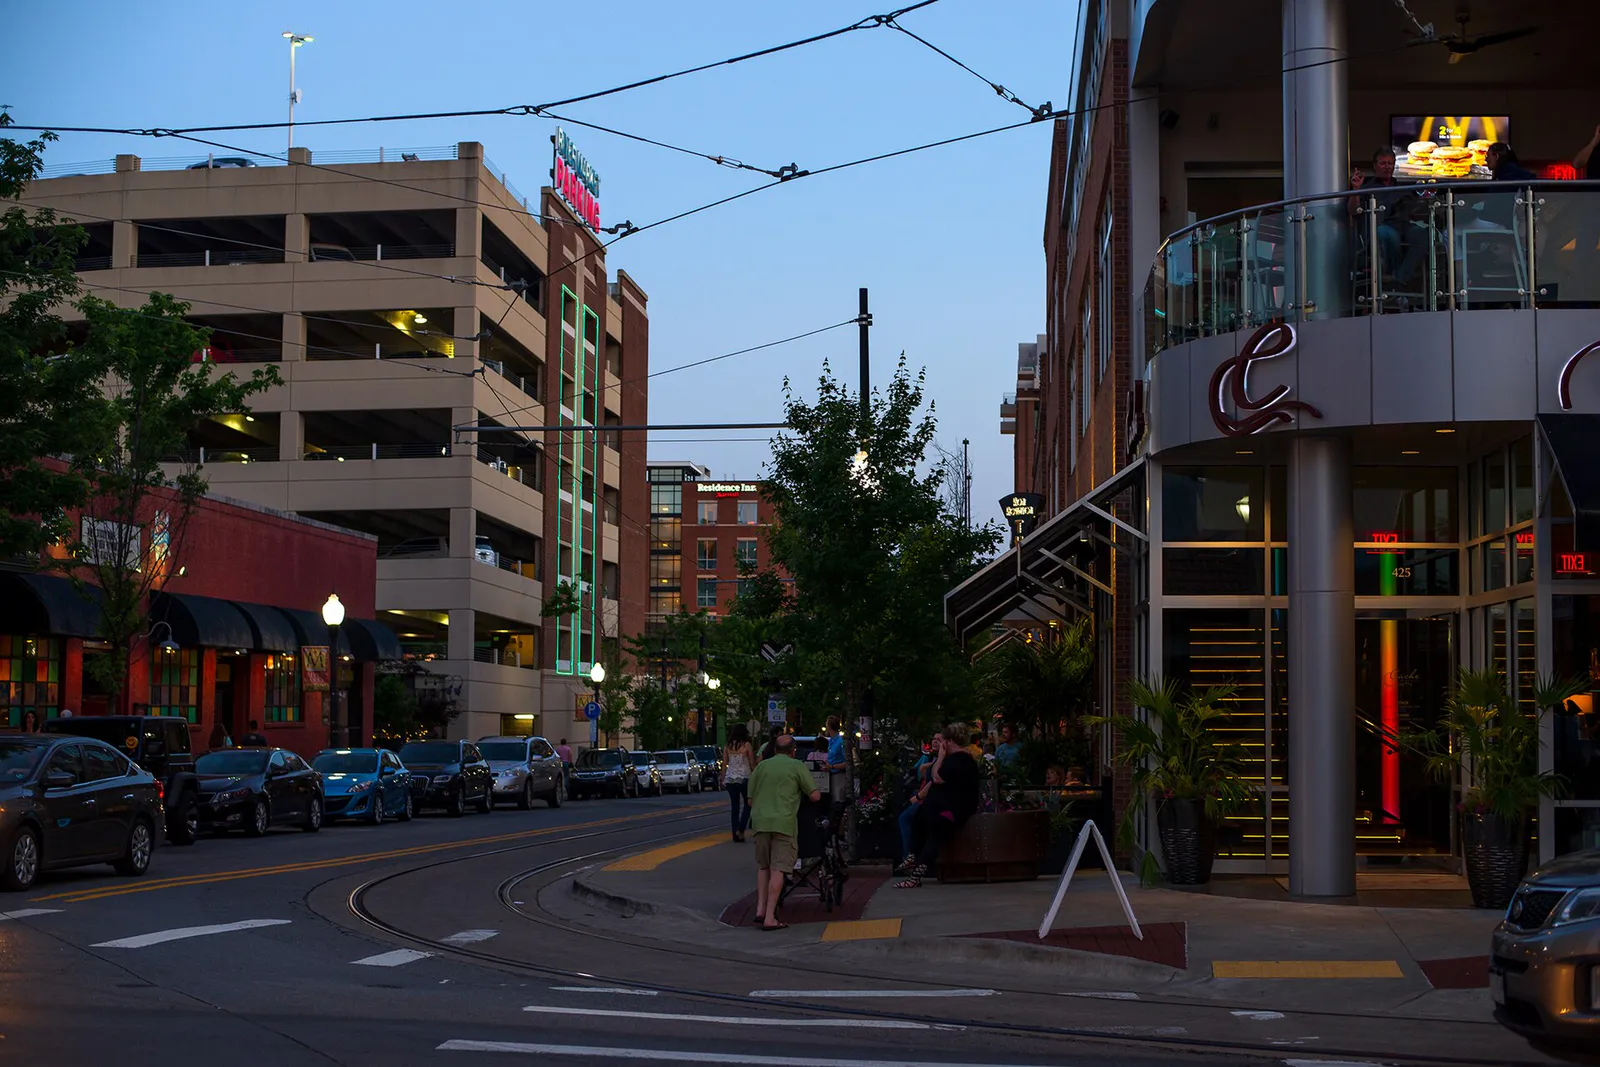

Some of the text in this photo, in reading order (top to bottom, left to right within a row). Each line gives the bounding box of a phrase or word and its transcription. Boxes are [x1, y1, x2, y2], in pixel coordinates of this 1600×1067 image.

[1439, 126, 1446, 135] 2
[555, 156, 600, 234] PARKING
[697, 483, 757, 492] Residence Inn
[1392, 567, 1411, 578] 425
[588, 703, 596, 715] P
